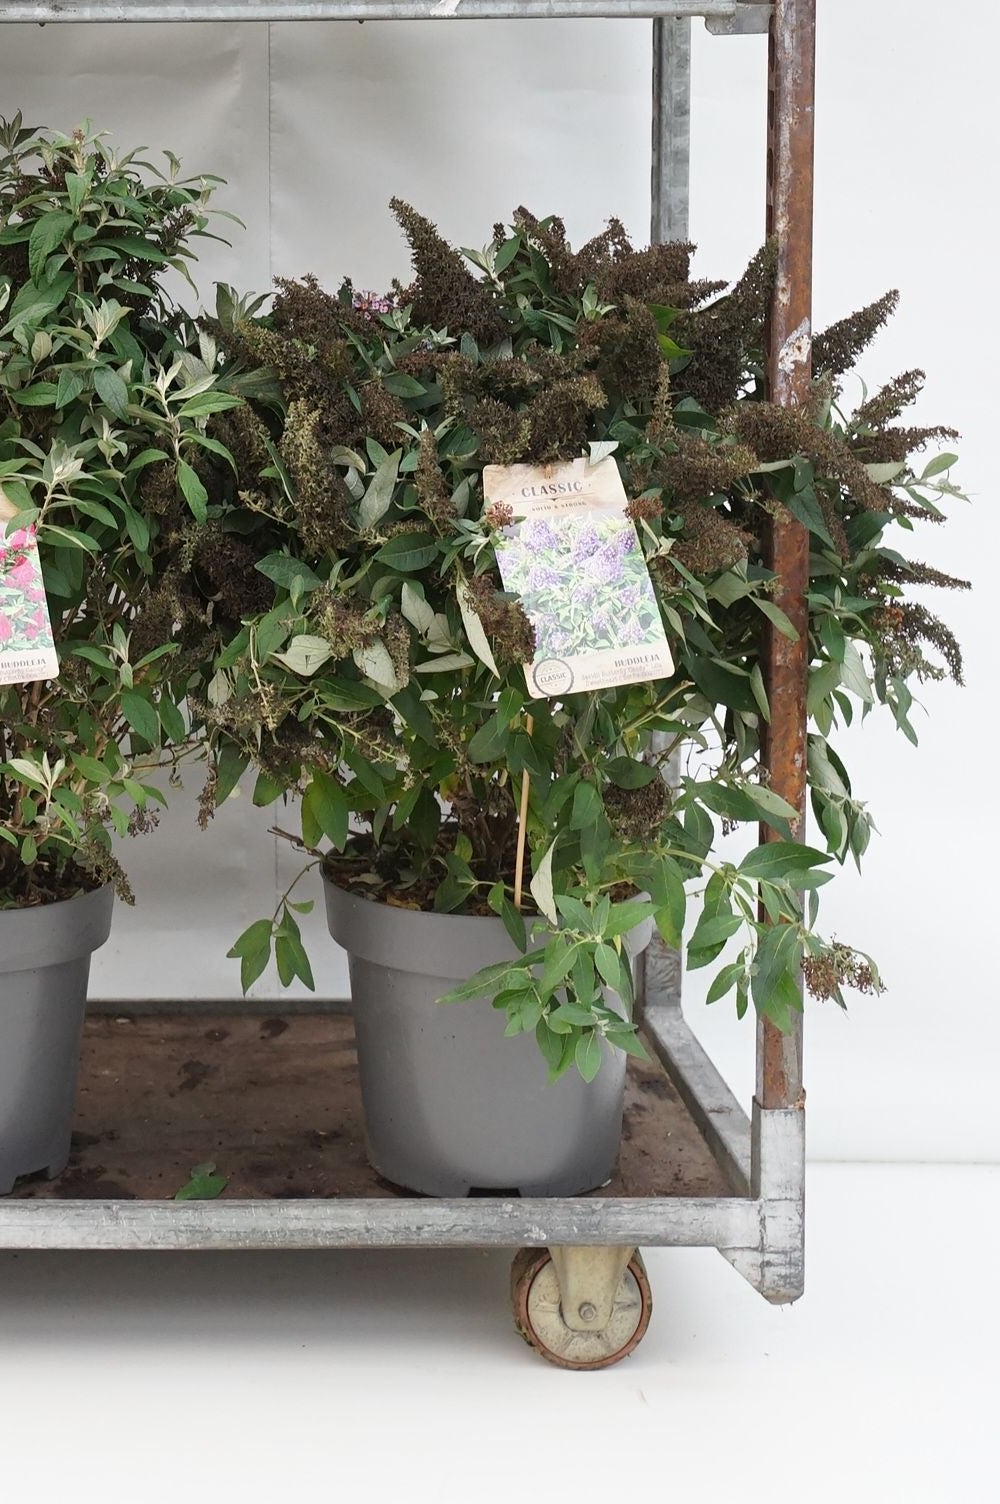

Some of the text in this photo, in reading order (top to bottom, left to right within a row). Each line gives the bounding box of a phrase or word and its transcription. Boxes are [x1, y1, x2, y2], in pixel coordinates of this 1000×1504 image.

[521, 481, 583, 498] CLASSIC
[0, 658, 47, 669] BUDDLEJA
[614, 653, 660, 668] BUDDLEJA
[540, 672, 566, 683] CLASSIC
